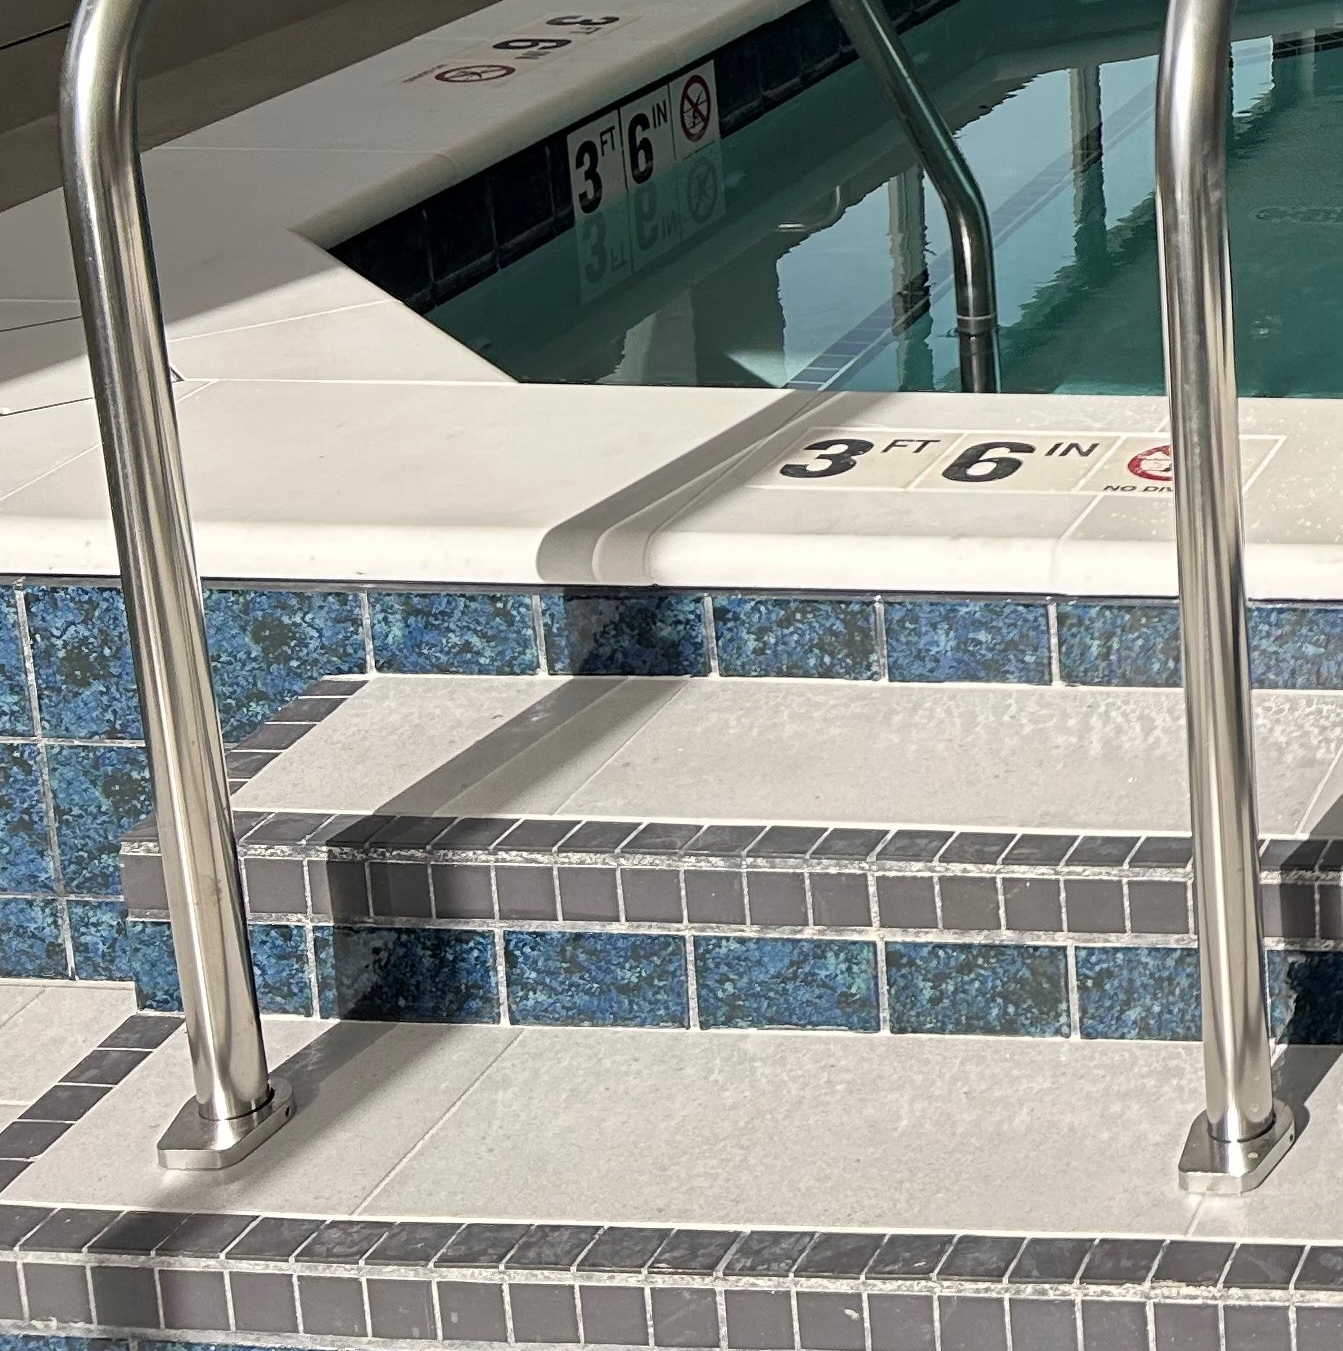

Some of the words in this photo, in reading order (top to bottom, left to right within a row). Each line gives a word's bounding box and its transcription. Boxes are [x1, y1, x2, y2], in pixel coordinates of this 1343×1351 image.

[546, 15, 620, 26] 3
[492, 38, 572, 50] 6
[575, 140, 603, 214] 3
[600, 125, 615, 157] FT
[627, 113, 654, 185] 6
[652, 100, 668, 129] IN
[779, 438, 875, 479] 3
[880, 439, 940, 455] FT
[941, 441, 1036, 483] 6
[1045, 441, 1100, 458] IN
